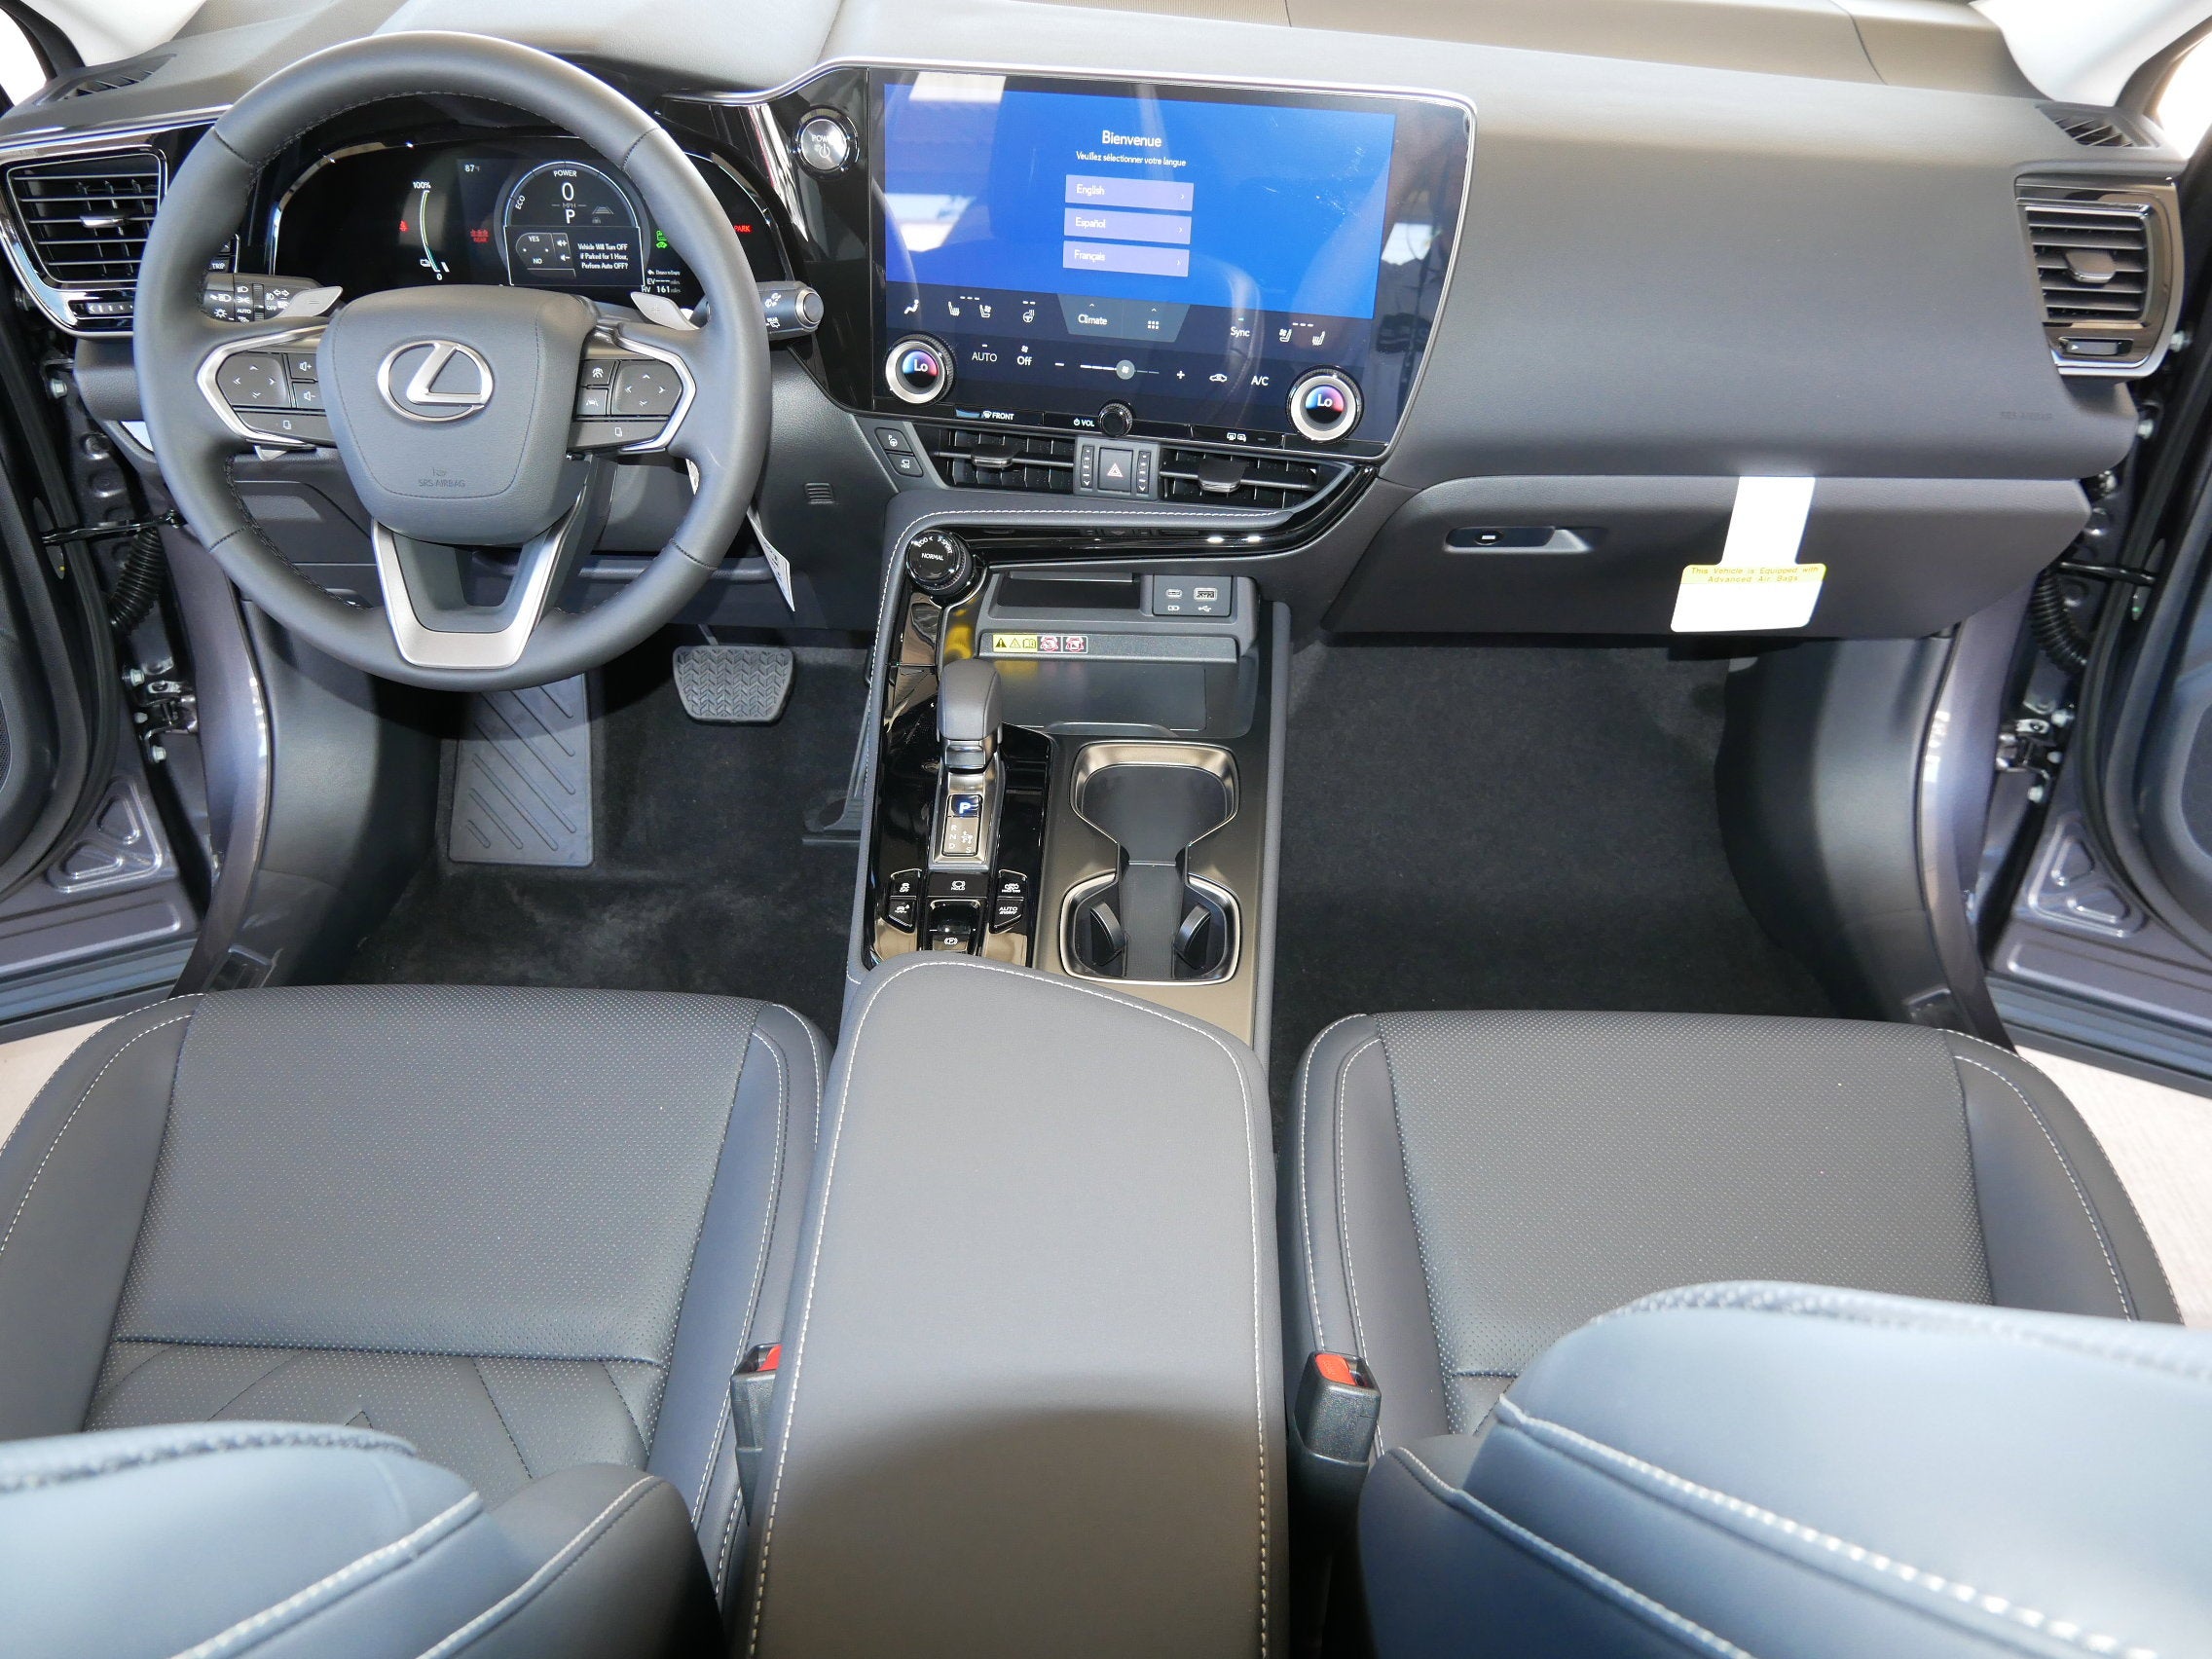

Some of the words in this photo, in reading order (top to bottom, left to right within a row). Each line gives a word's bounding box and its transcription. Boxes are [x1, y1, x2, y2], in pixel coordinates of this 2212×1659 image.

[1102, 129, 1162, 147] Bienvenue
[1076, 151, 1102, 161] Veuillez
[1103, 153, 1143, 164] sélectionner
[1144, 157, 1162, 166] votre
[1163, 157, 1187, 168] langue
[1076, 184, 1105, 196] English
[515, 195, 526, 210] ECO
[565, 209, 575, 224] P
[1075, 217, 1106, 229] Español
[1074, 249, 1106, 262] Français
[1078, 314, 1108, 326] Climate
[1230, 326, 1250, 338] Sync
[972, 351, 998, 363] AUTO
[1017, 356, 1033, 367] Off
[914, 359, 928, 372] Lo
[1251, 376, 1270, 387] A/C
[1317, 394, 1333, 407] Lo
[992, 412, 1014, 421] FRONT
[1081, 419, 1095, 428] VOL
[921, 553, 944, 561] NORMAL
[959, 802, 971, 814] P
